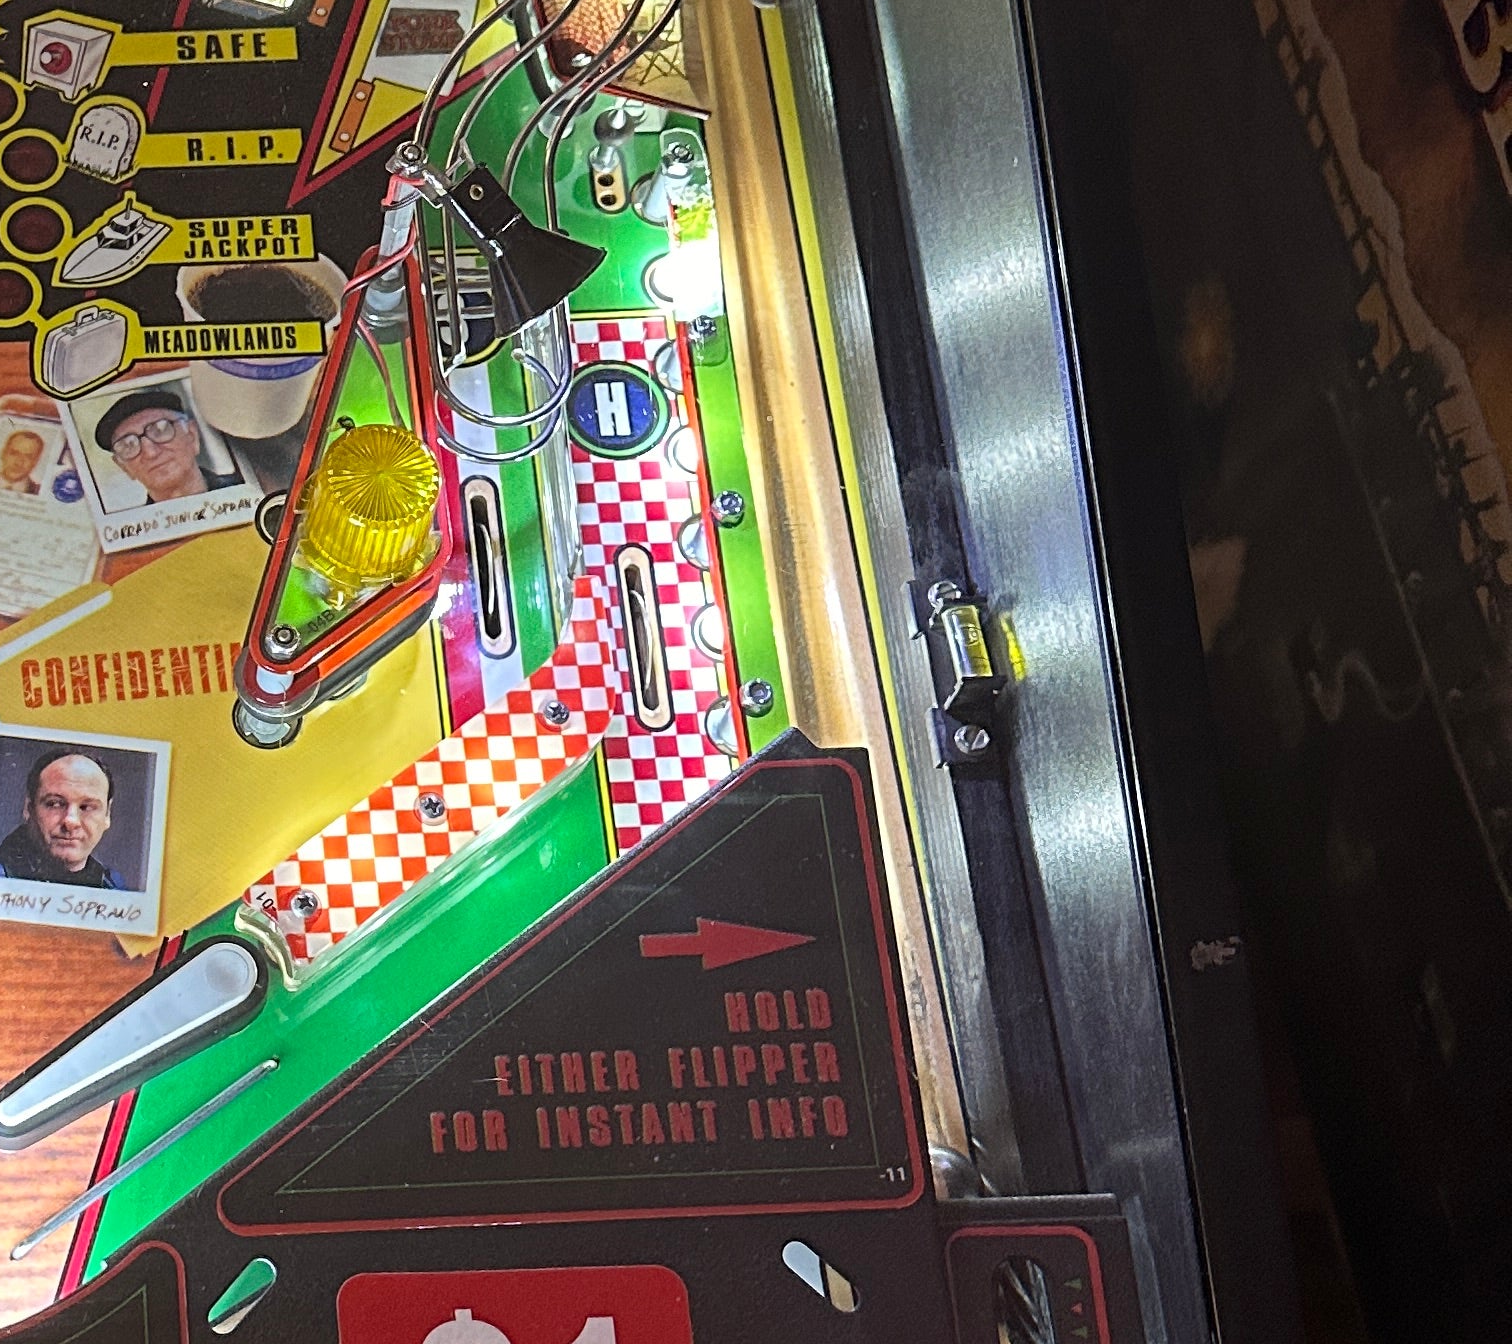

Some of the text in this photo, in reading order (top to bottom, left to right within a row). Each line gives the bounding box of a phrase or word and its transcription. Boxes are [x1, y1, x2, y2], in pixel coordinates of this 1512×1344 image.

[176, 33, 268, 61] SAFE
[79, 122, 121, 151] R.I.P.
[188, 218, 300, 238] SUPER
[184, 237, 302, 259] JACKPOT
[144, 325, 298, 354] MEADOWLANDS
[594, 381, 632, 437] H
[103, 518, 159, 543] CORRADO
[56, 893, 142, 922] SOPRANO
[725, 987, 834, 1033] HOLD
[494, 1041, 841, 1097] EITHER FLIPPER
[430, 1094, 849, 1154] FOR INSTANT INFO
